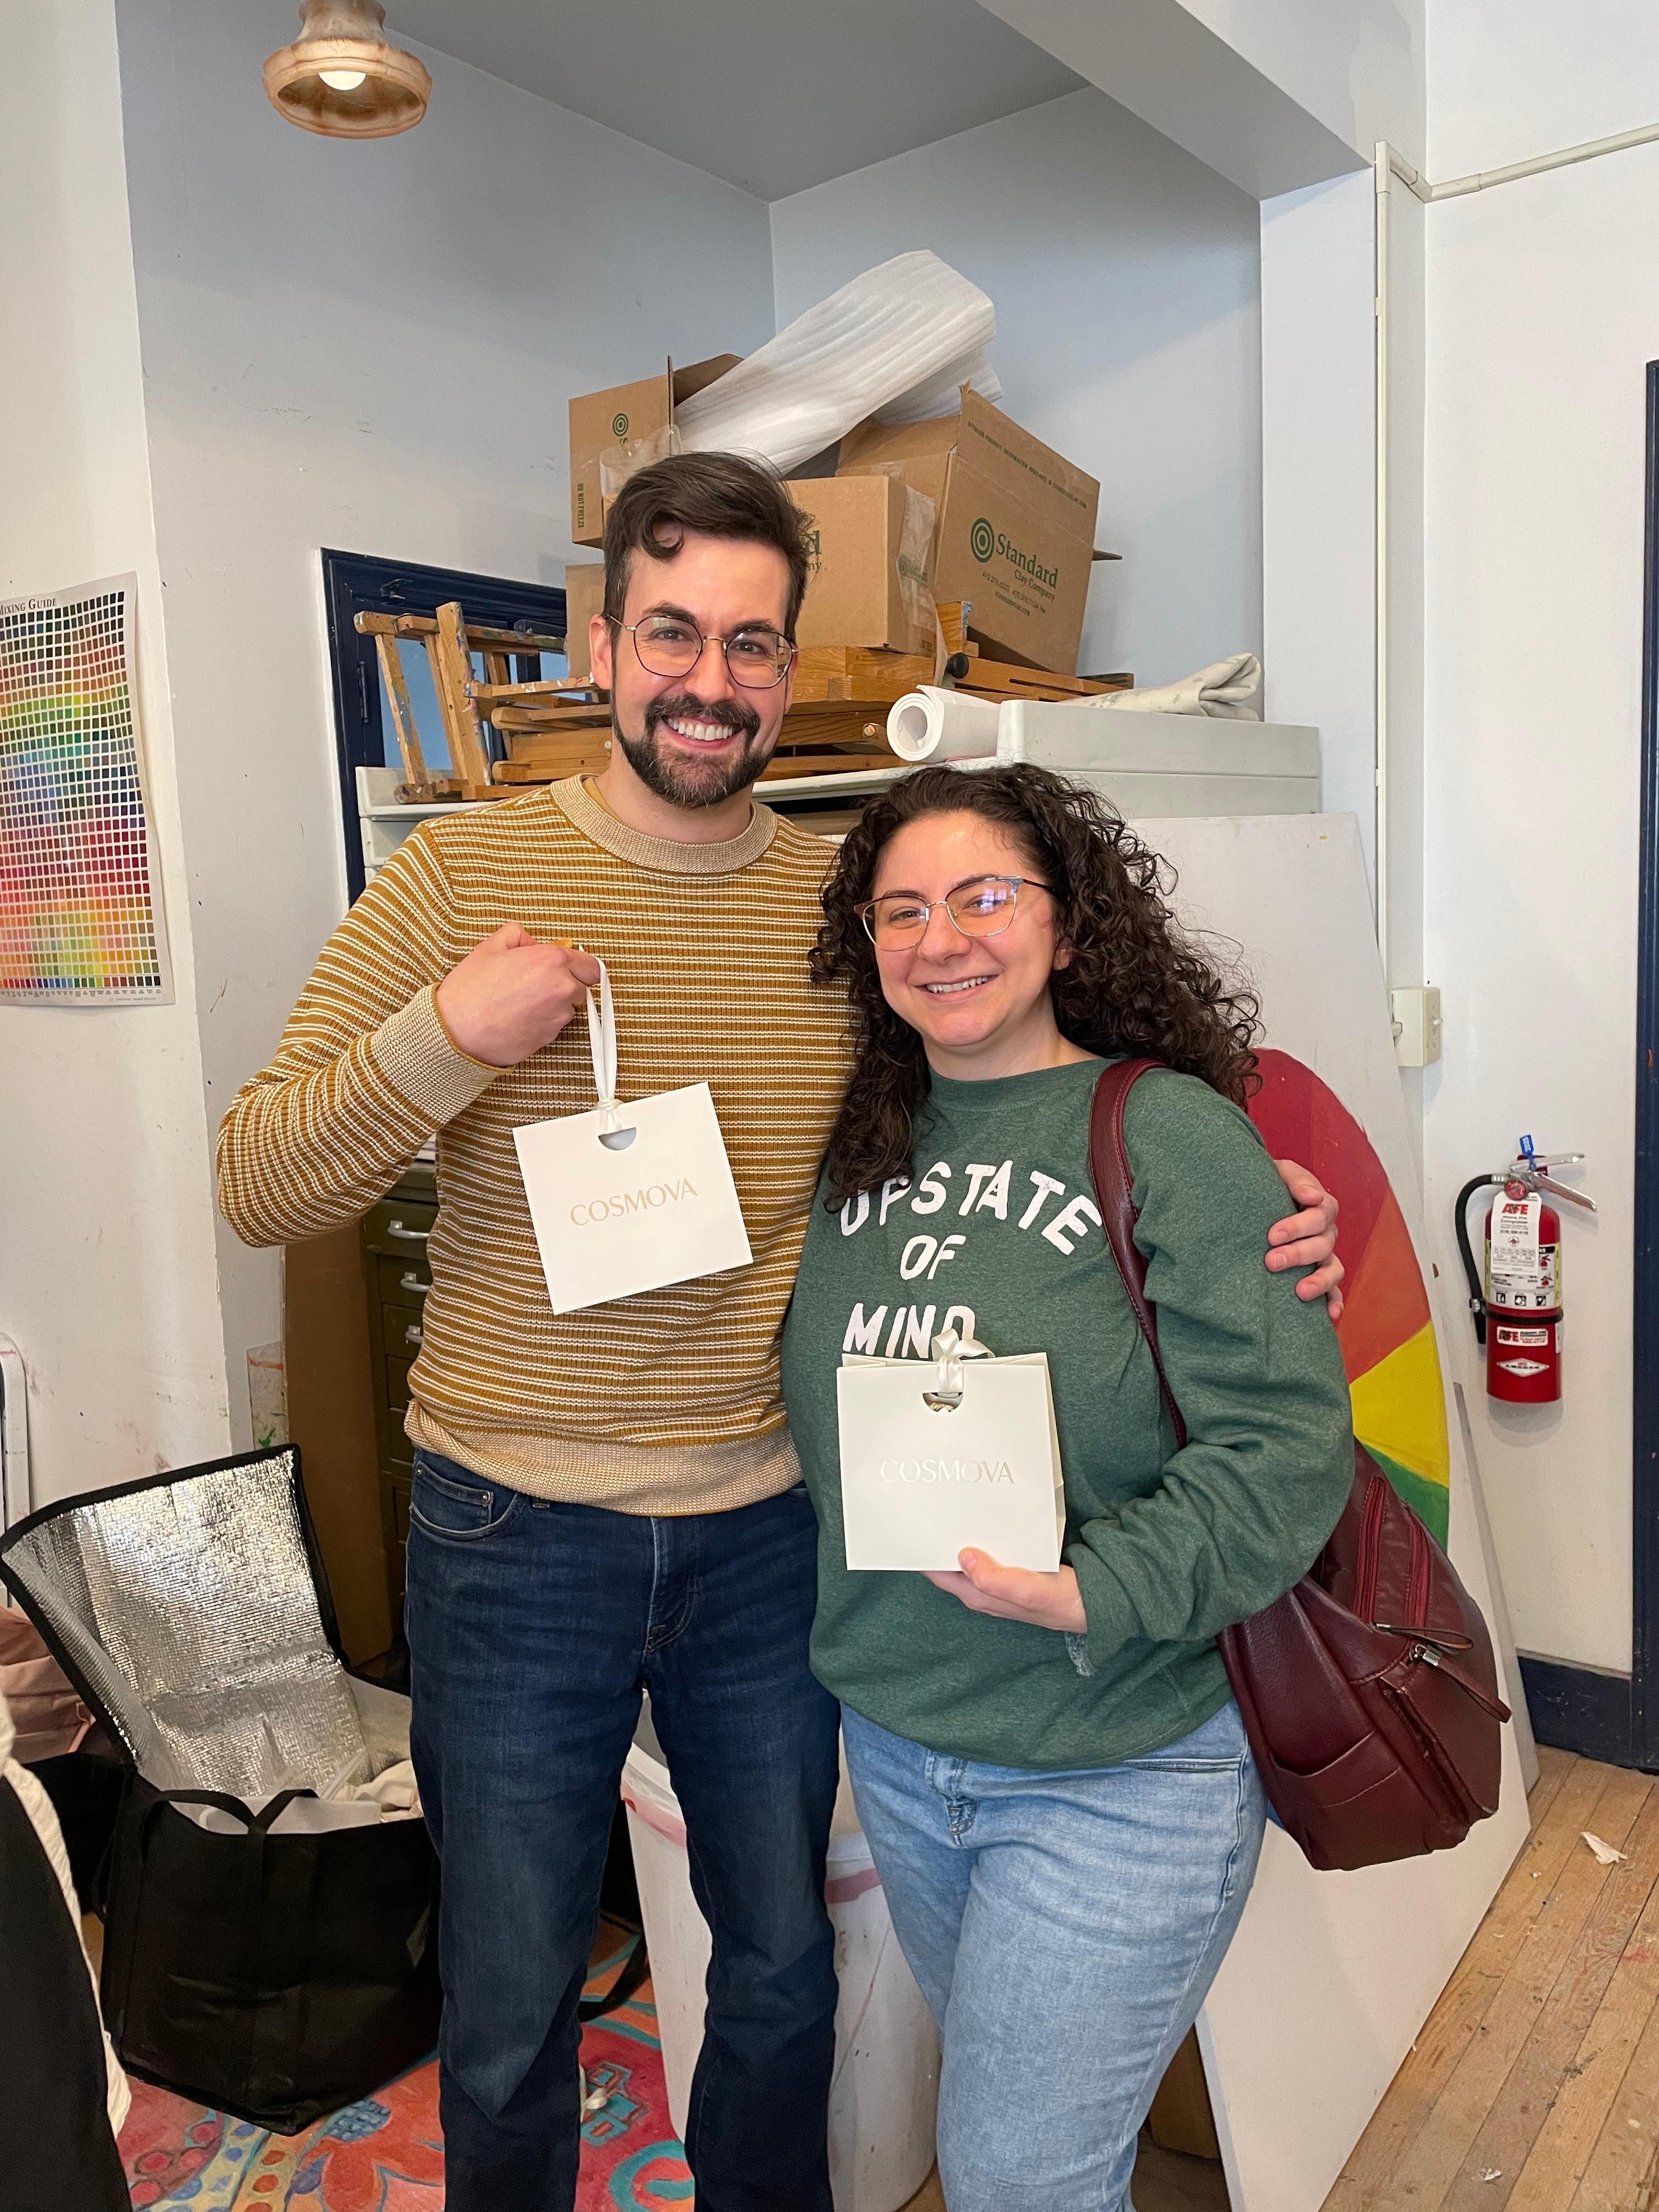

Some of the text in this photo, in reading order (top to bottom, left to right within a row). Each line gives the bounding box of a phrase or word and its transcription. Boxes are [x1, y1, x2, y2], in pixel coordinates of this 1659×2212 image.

[996, 533, 1058, 589] Standard
[28, 597, 57, 610] GUIDE
[1014, 569, 1028, 588] Clay
[1028, 578, 1056, 603] Company
[569, 1177, 698, 1227] COSMOVA
[839, 1159, 1103, 1256] UPSTATE
[899, 1234, 966, 1280] OF
[879, 1458, 1015, 1485] COSMOVA
